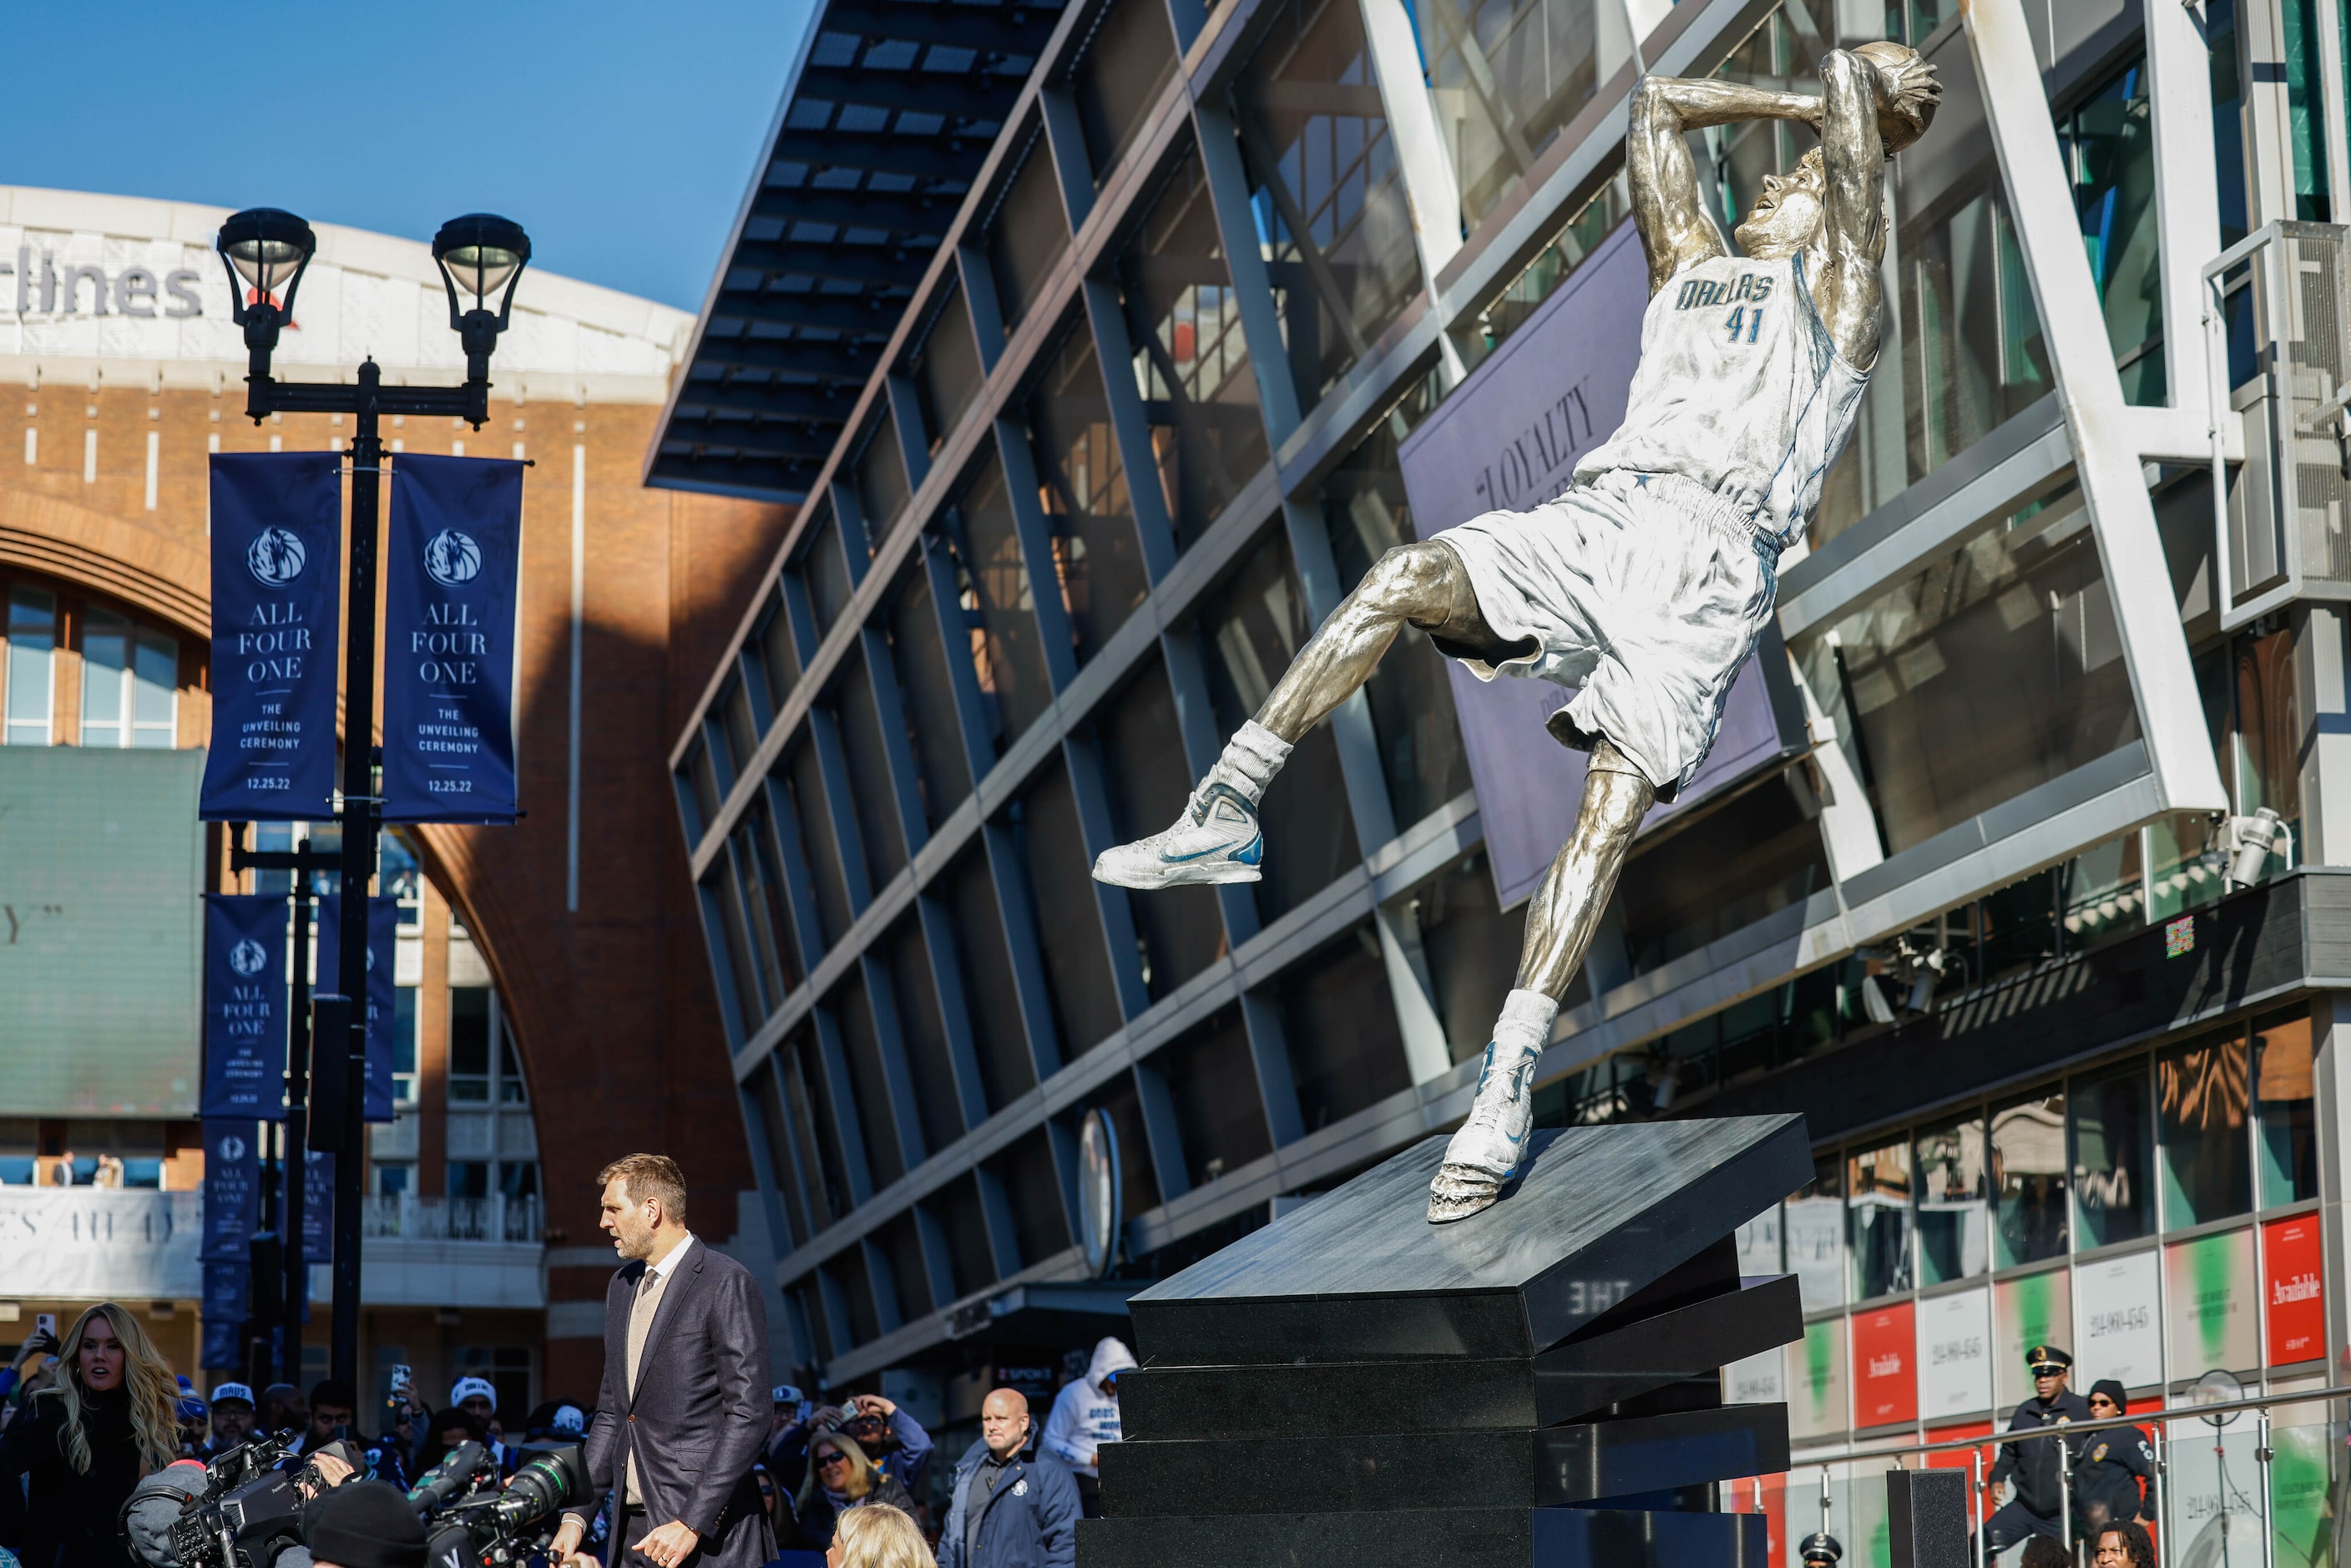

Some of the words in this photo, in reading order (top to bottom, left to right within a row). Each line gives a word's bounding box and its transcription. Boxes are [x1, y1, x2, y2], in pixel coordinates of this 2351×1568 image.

[1676, 274, 1774, 310] DALLAS
[1725, 305, 1763, 345] 41
[250, 602, 301, 625] ALL
[422, 603, 478, 626] ALL
[238, 628, 311, 655] FOUR
[411, 631, 488, 655] FOUR
[247, 657, 301, 683] ONE
[419, 661, 477, 684] ONE
[261, 704, 281, 715] THE
[438, 709, 459, 721] THE
[242, 721, 301, 733] UNVEILING
[418, 725, 479, 738] UNVEILING
[240, 738, 300, 750] CEREMONY
[419, 741, 478, 754] CEREMONY
[247, 777, 291, 790] 12.25.22
[428, 780, 473, 792] 12.25.22
[2273, 1272, 2321, 1305] Available
[219, 1386, 246, 1398] MAVS
